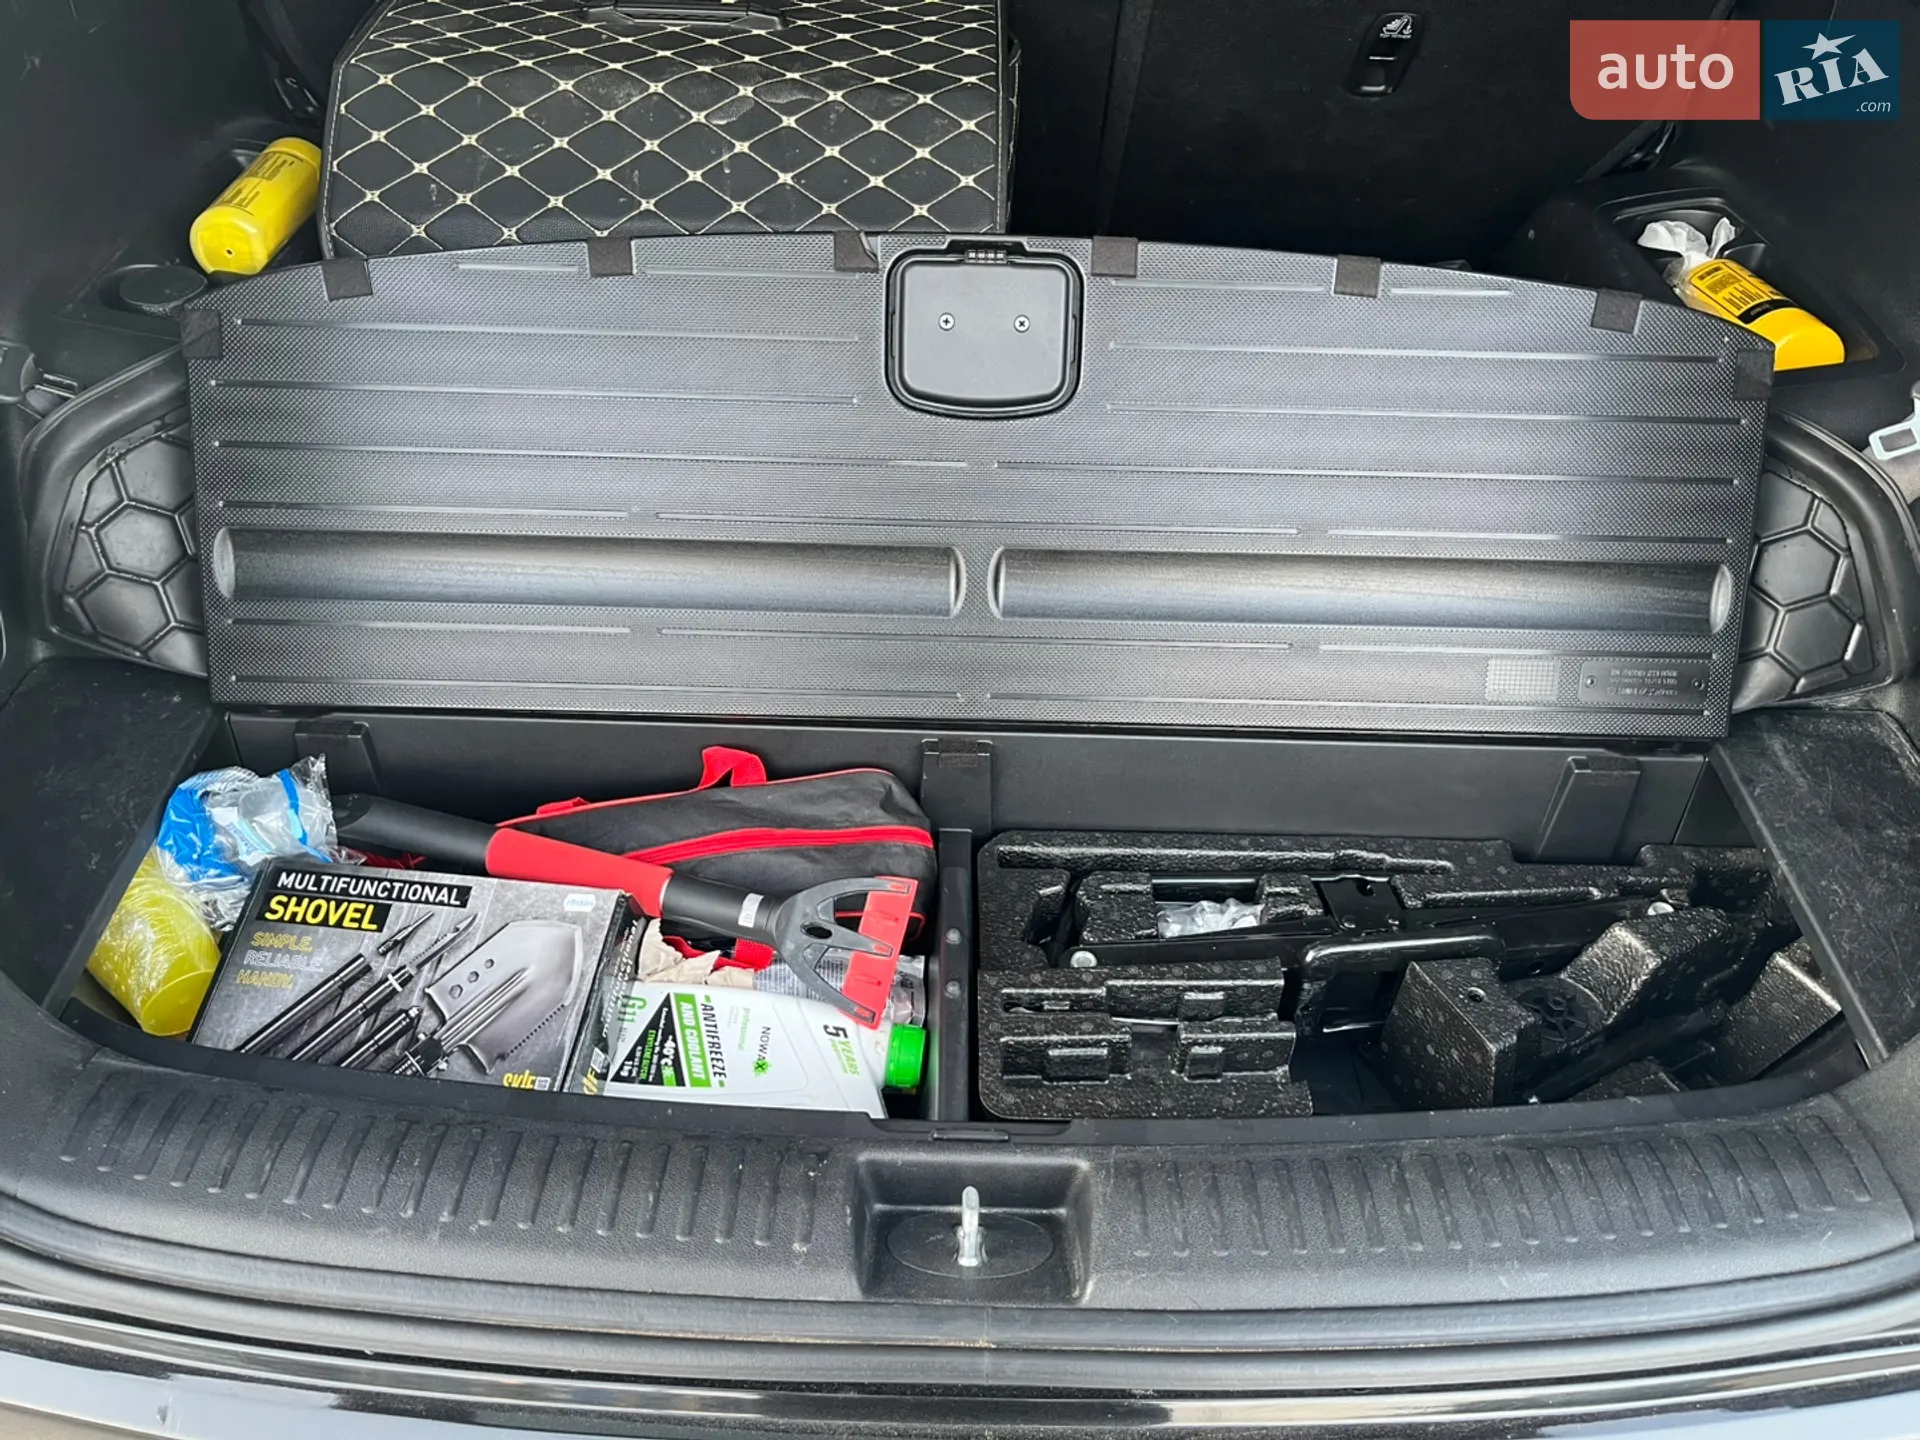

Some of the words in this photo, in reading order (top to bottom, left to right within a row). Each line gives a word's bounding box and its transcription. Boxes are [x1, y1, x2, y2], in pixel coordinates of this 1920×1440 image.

[277, 870, 461, 905] MULTIFUNCTIONAL
[264, 895, 379, 930] SHOVEL
[680, 1001, 695, 1027] AND
[823, 1024, 849, 1039] 5
[685, 1029, 705, 1080] COOLANT
[701, 1003, 727, 1078] ANTIFREEZE
[755, 1026, 771, 1071] NOWAX
